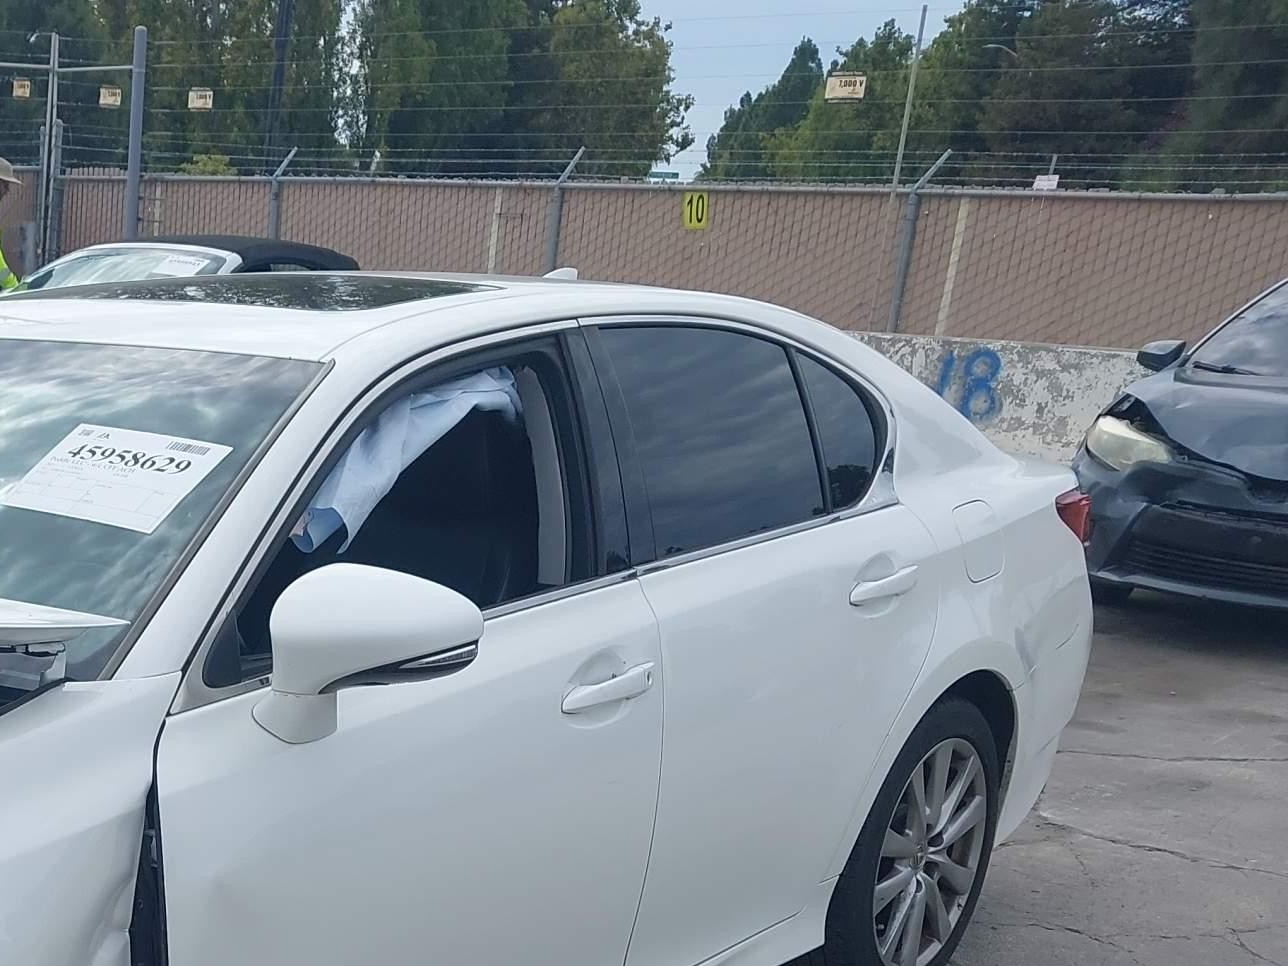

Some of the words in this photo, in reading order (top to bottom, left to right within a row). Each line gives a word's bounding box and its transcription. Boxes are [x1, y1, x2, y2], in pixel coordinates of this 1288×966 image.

[687, 194, 705, 223] 10
[937, 348, 1002, 421] 18
[67, 443, 192, 475] 45958629
